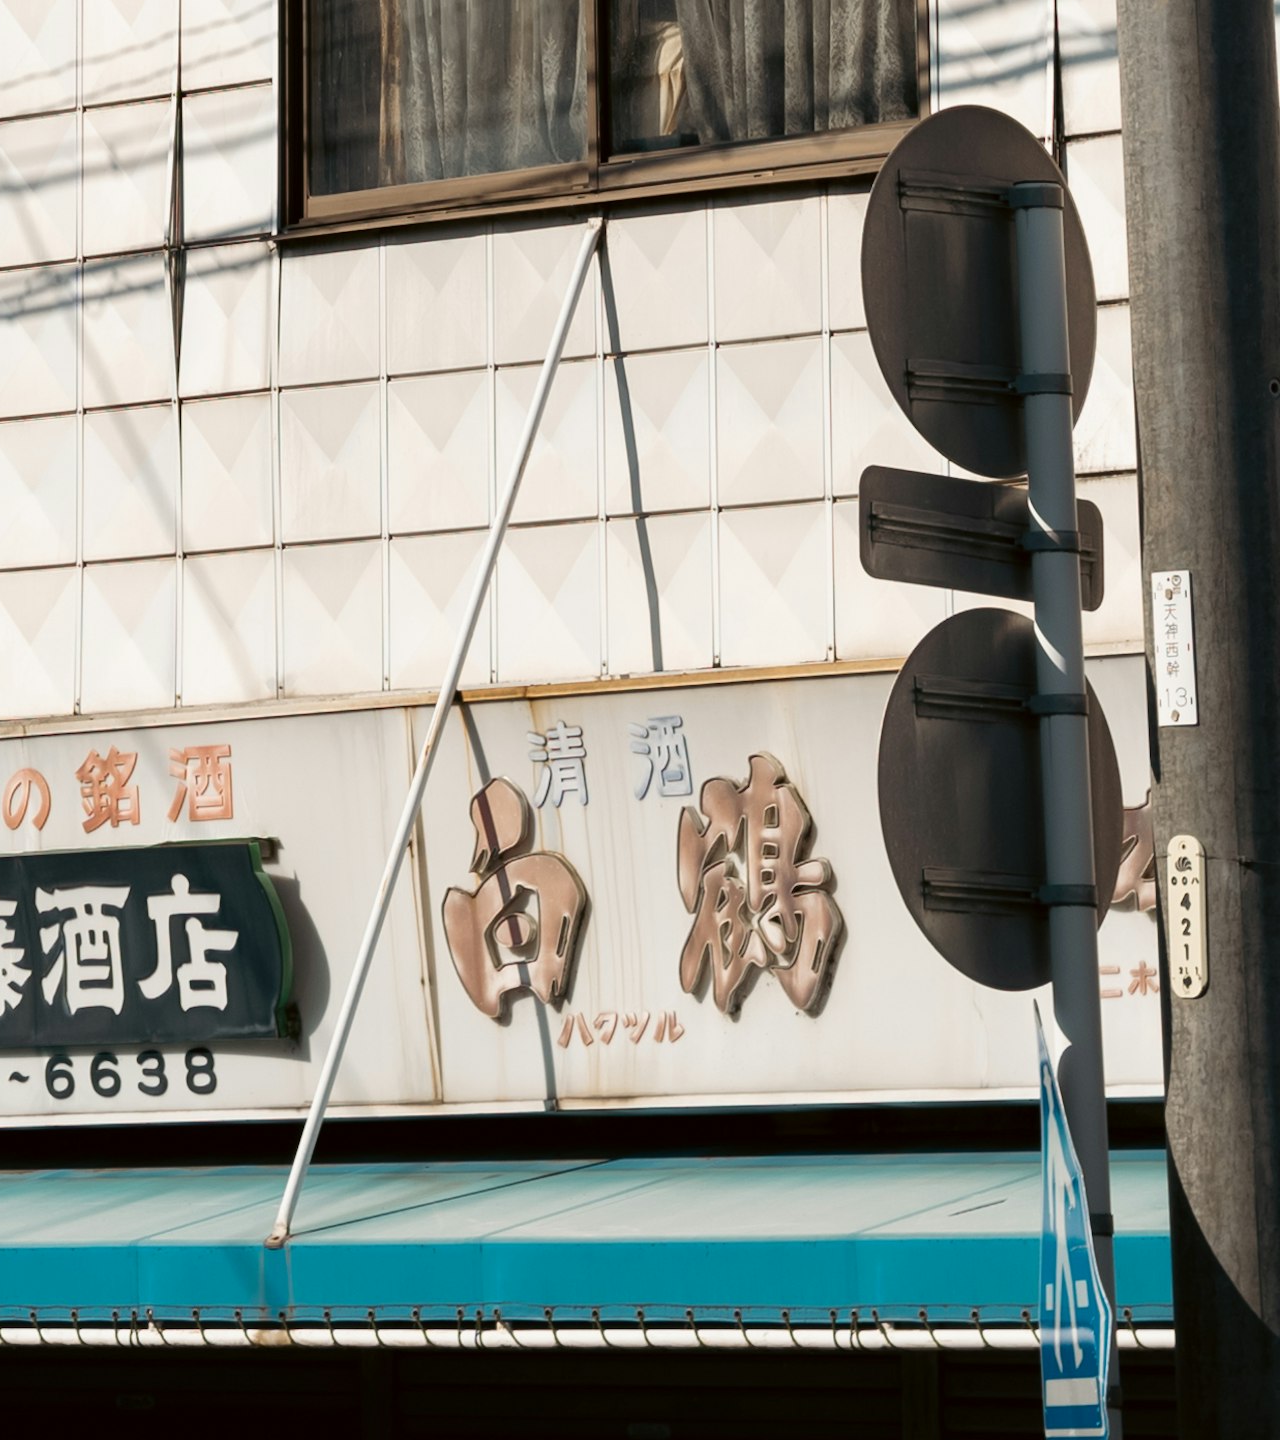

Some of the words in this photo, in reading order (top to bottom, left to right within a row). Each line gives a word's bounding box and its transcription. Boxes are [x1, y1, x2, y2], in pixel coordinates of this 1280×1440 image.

[1166, 687, 1188, 708] 13
[441, 750, 845, 1020] 白鶴
[557, 1010, 687, 1048] ハクツル
